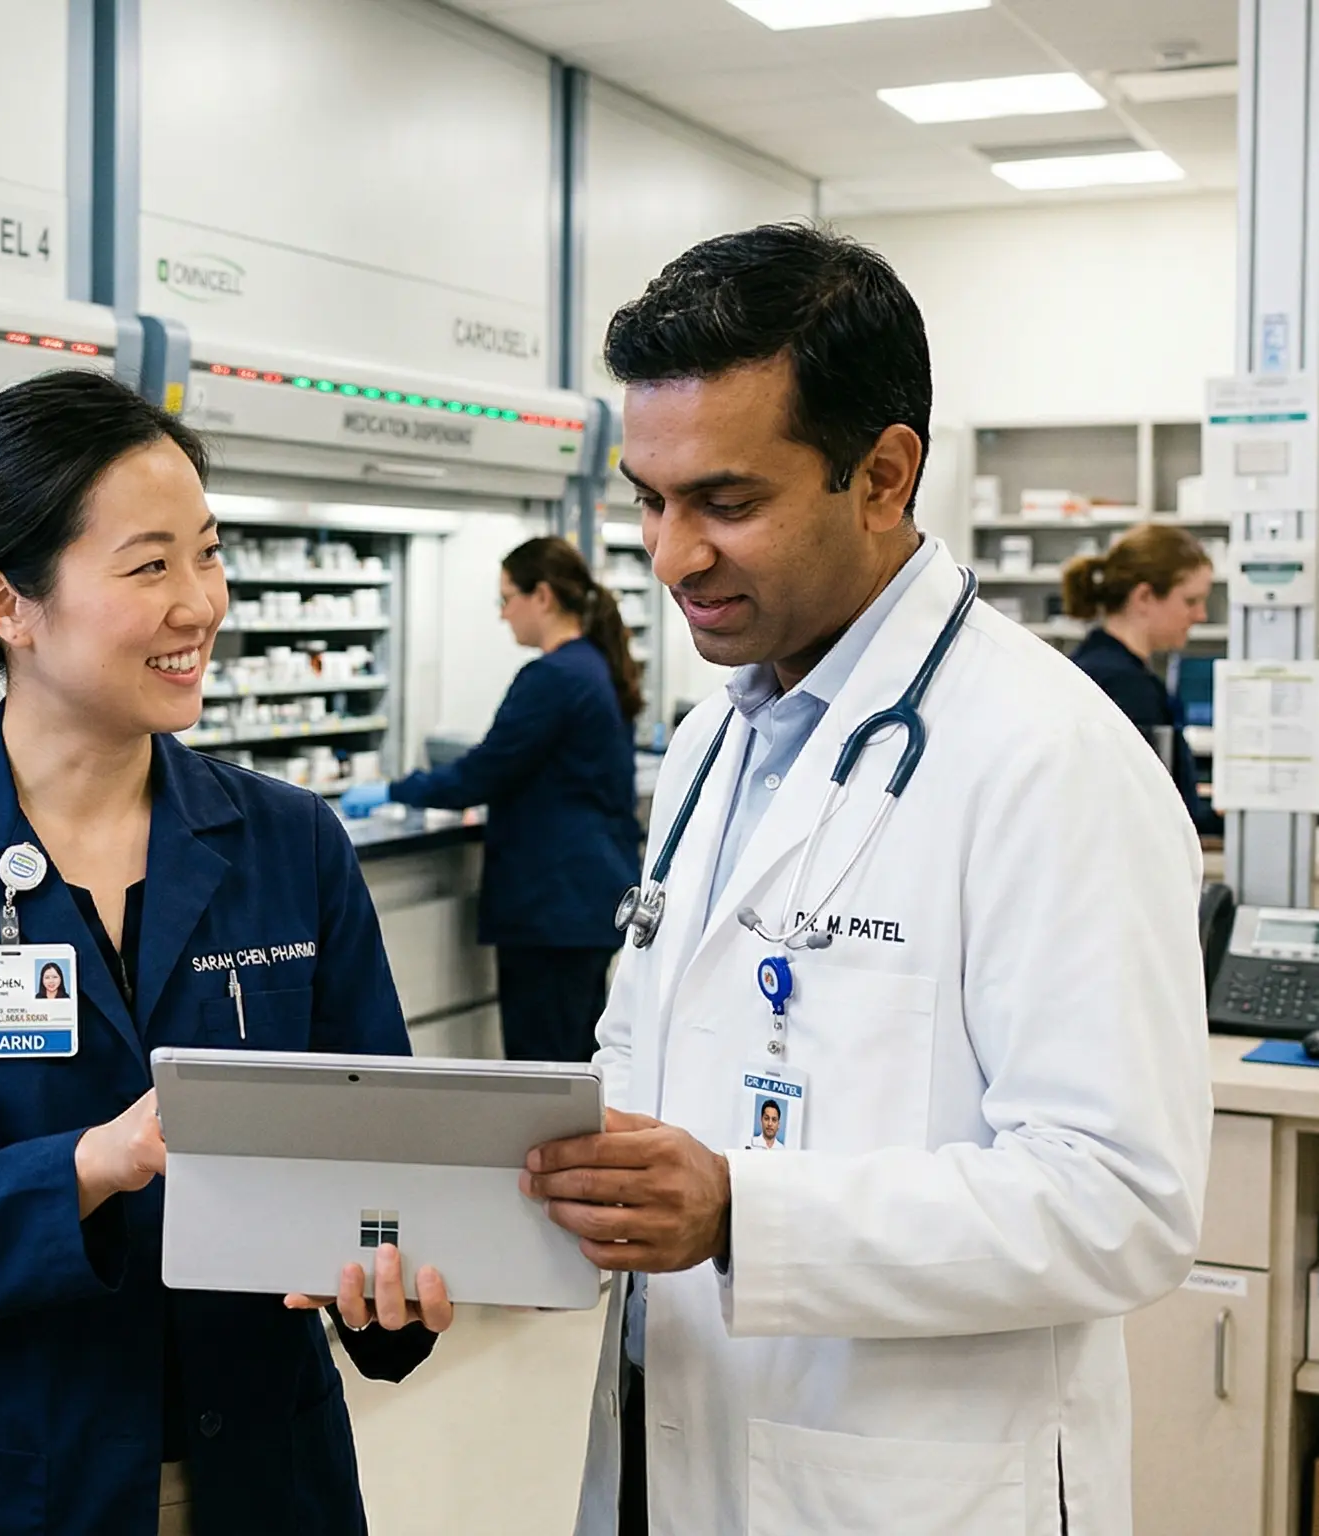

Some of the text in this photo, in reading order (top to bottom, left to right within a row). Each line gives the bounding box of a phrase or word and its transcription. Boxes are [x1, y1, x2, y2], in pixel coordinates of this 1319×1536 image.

[37, 227, 51, 262] 4
[826, 914, 843, 935] M.
[848, 917, 906, 943] PATEL
[192, 953, 235, 972] SARAH
[236, 948, 271, 967] CHEN,
